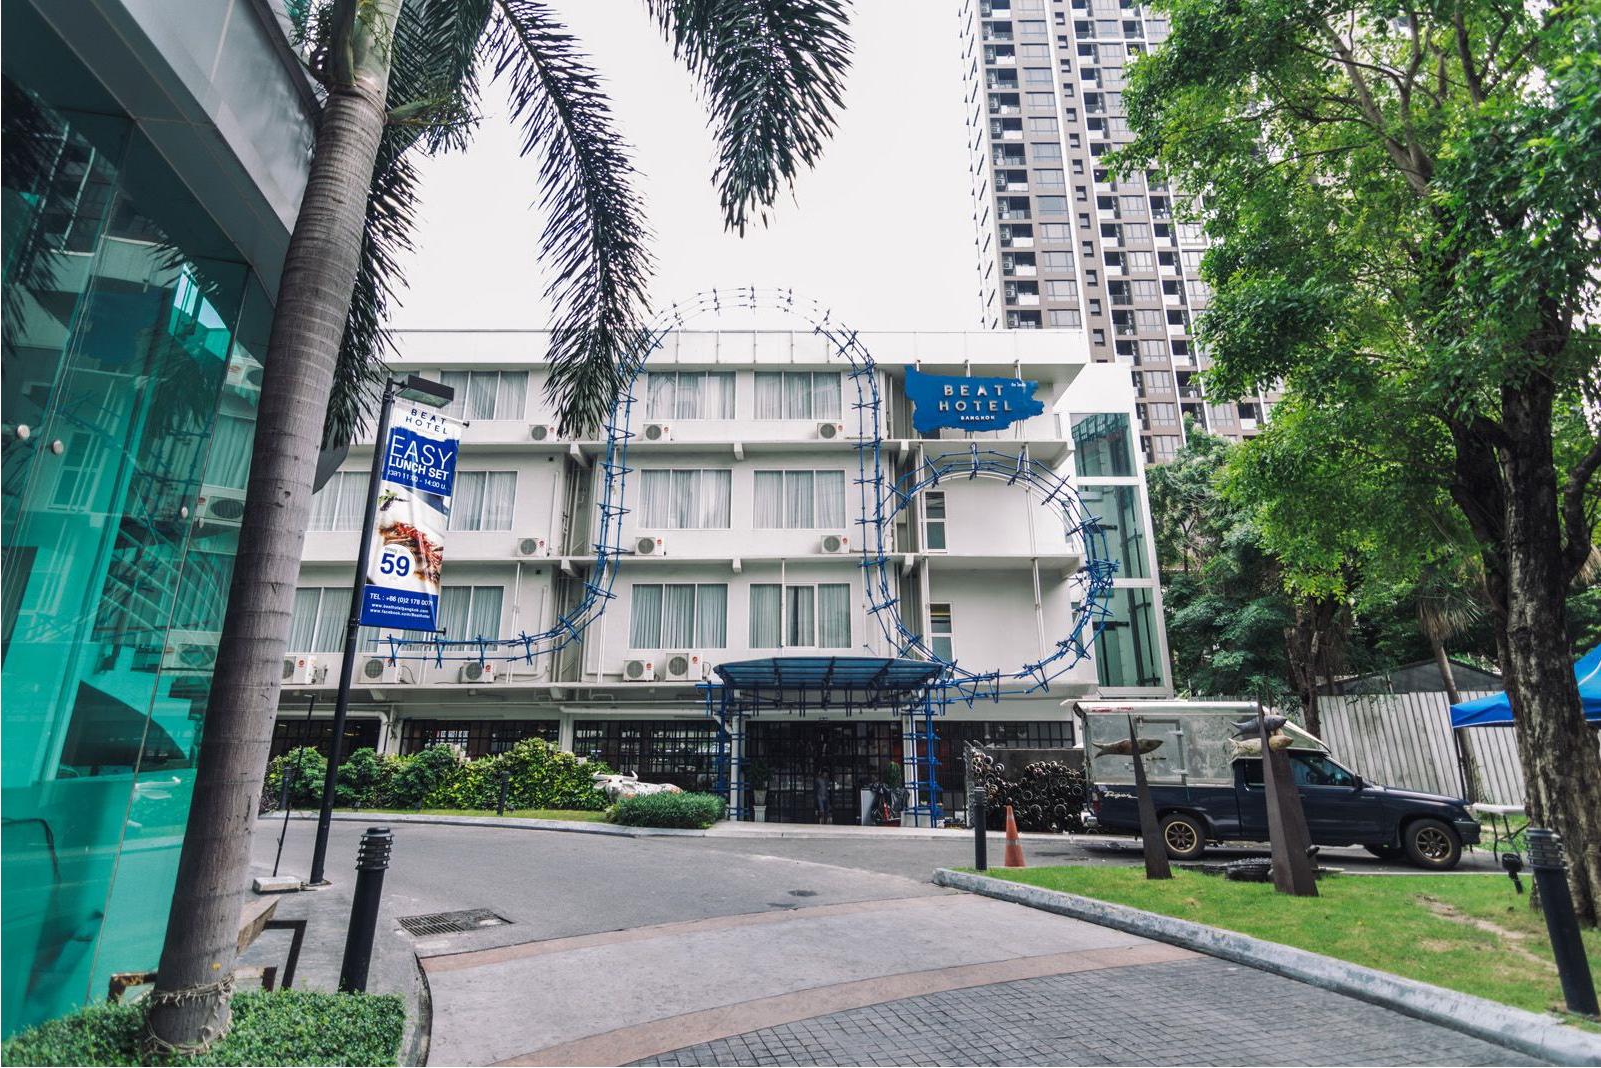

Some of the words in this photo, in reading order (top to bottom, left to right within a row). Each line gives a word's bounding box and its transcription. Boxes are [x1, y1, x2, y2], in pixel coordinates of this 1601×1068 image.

[944, 384, 1004, 397] BEAT
[939, 400, 1013, 412] HOTEL
[405, 416, 447, 434] HOTEL
[411, 408, 446, 424] BEAT
[391, 435, 453, 470] EASY
[389, 456, 426, 475] LUNCH
[429, 467, 449, 480] SET
[380, 553, 410, 577] 59
